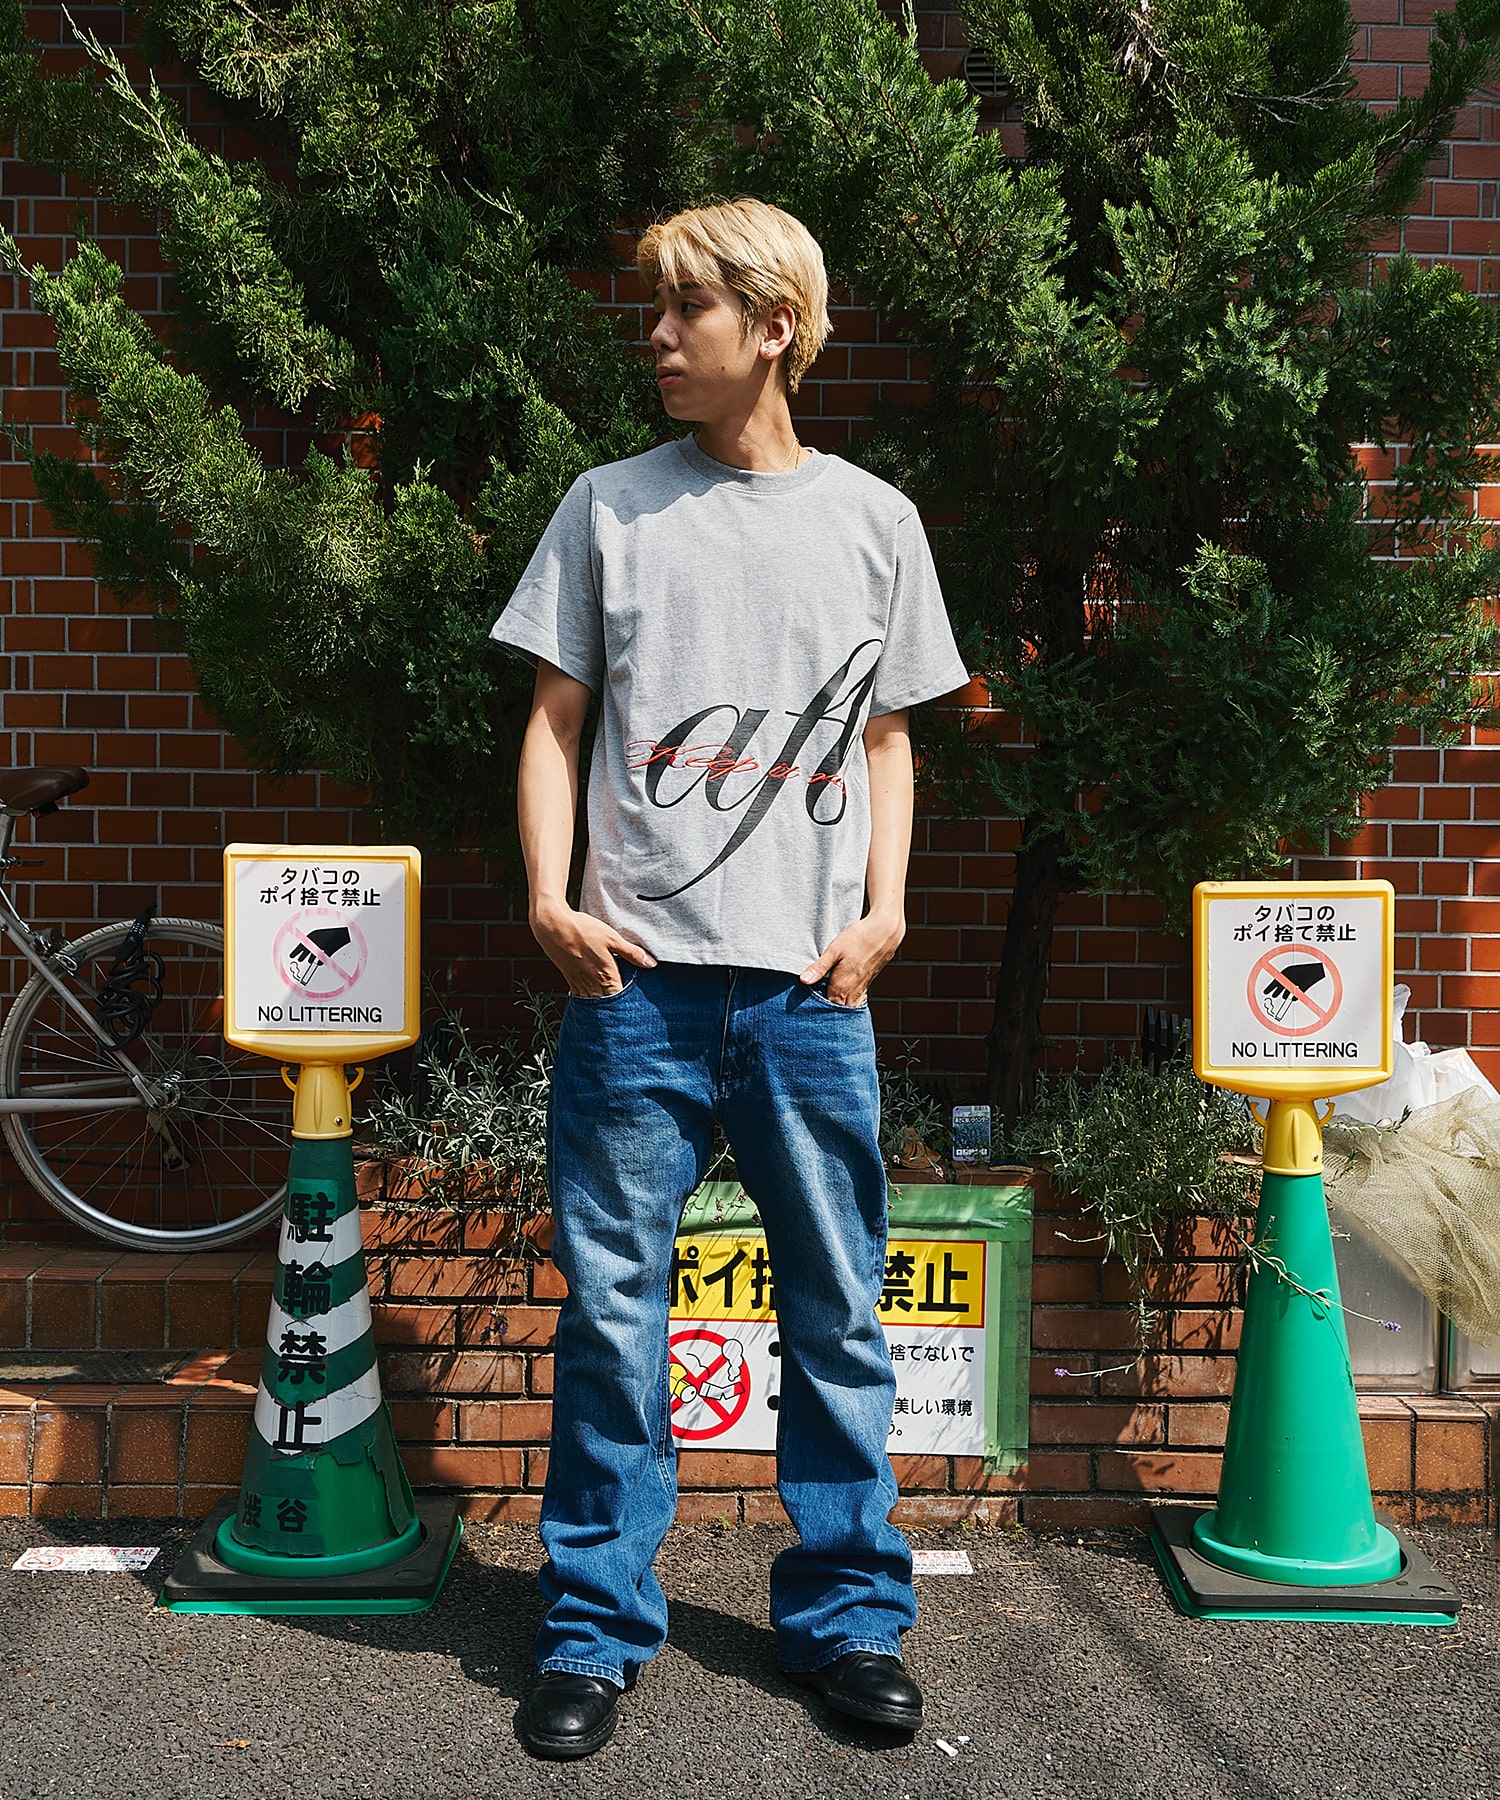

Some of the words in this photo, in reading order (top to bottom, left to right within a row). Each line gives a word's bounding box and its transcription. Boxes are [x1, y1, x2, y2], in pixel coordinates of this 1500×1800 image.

[280, 867, 360, 886] タバコの
[259, 886, 381, 907] ポイ捨て禁止
[1254, 904, 1335, 923] タバコの
[1233, 923, 1356, 942] ポイ捨て禁止
[258, 1006, 283, 1022] NO
[289, 1006, 382, 1023] LITTERING
[1232, 1042, 1257, 1058] NO
[1263, 1042, 1358, 1058] LITTERING
[272, 1191, 336, 1451] 駐輪禁止
[890, 1344, 975, 1363] 捨てないで
[894, 1397, 973, 1416] 美しい環境
